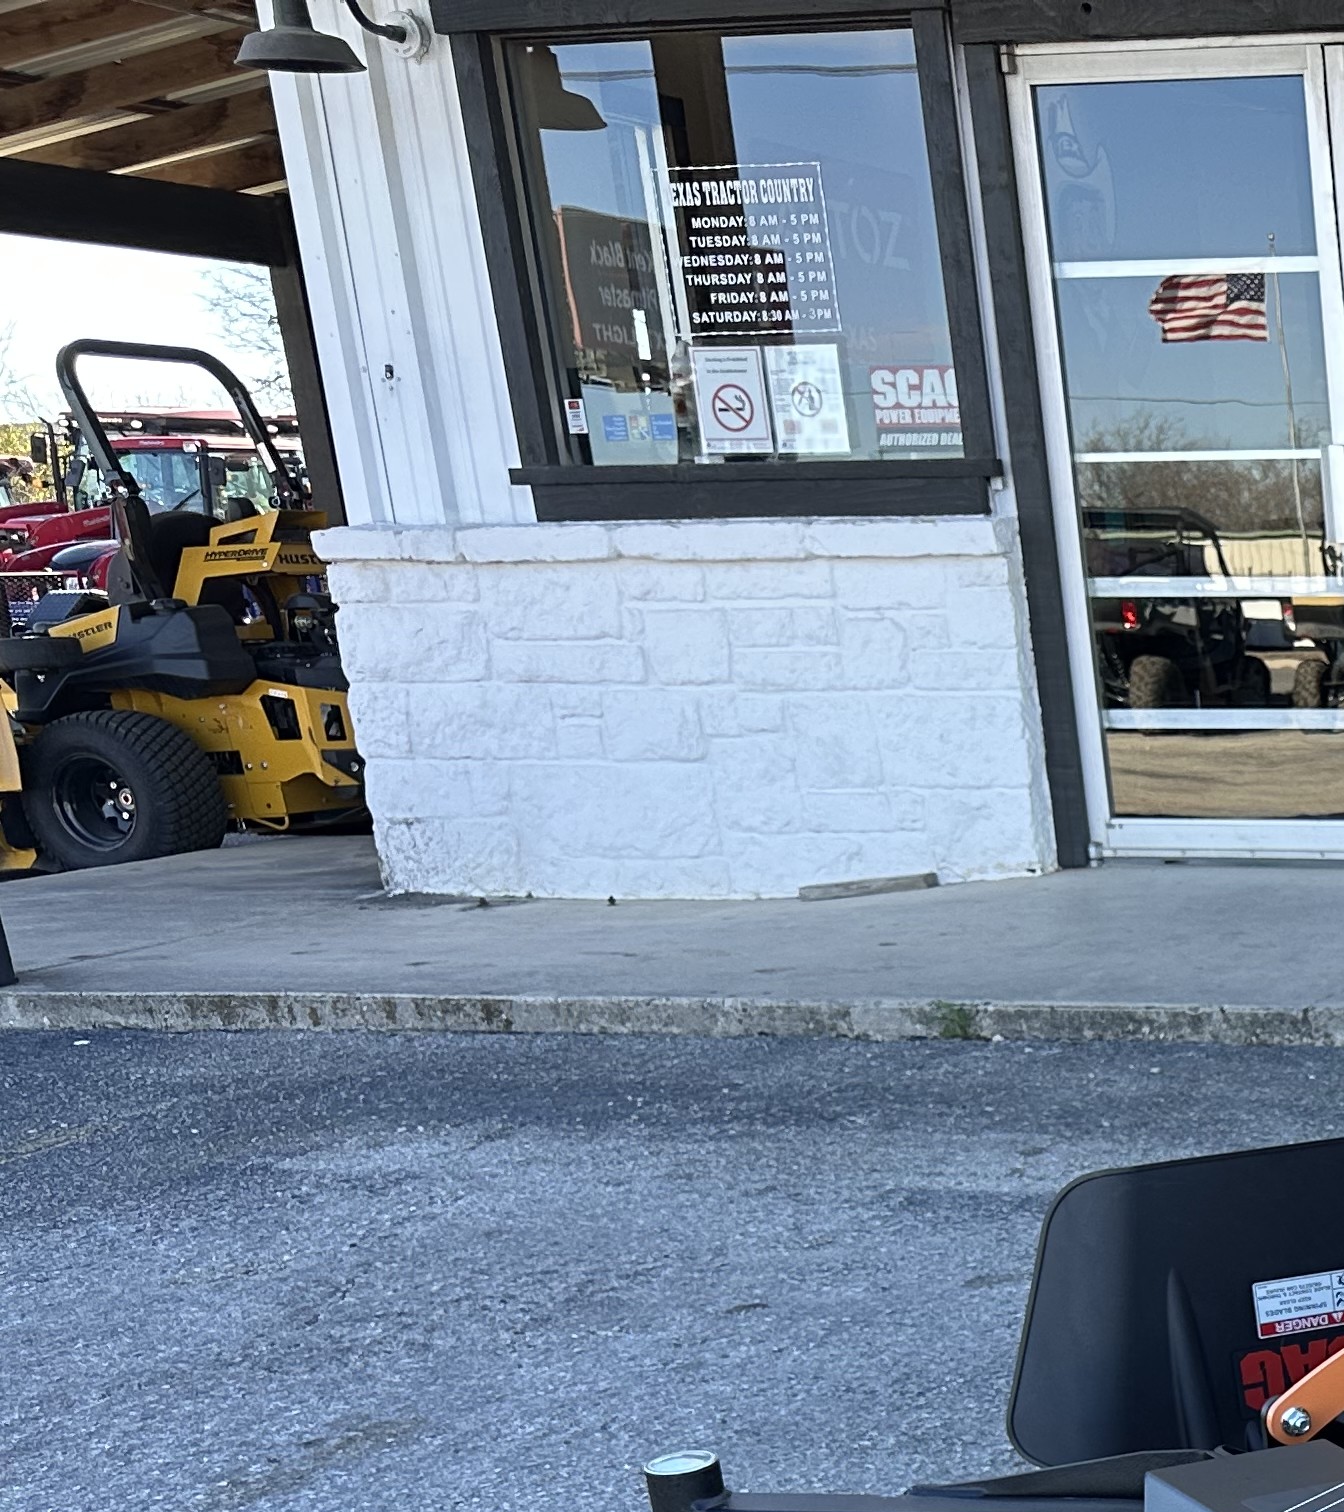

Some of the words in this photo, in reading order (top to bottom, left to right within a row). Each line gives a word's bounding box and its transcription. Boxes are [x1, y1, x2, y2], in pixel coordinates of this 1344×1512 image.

[671, 180, 701, 207] EXAS
[702, 178, 759, 206] TRACTOR
[759, 177, 815, 204] COUNTRY
[749, 215, 756, 227] 8
[759, 215, 778, 227] AM
[790, 214, 797, 226] 5
[801, 213, 819, 225] PM
[751, 234, 758, 246] 8
[761, 233, 781, 246] AM
[793, 233, 800, 245] 5
[803, 232, 822, 244] PM
[754, 254, 761, 265] 8
[765, 253, 783, 265] AM
[795, 252, 802, 264] 5
[806, 251, 825, 263] PM
[757, 272, 764, 284] 8
[767, 271, 786, 283] AM
[798, 271, 805, 282] 5
[808, 270, 827, 282] PM
[759, 292, 766, 303] 8
[769, 290, 789, 302] AM
[800, 290, 807, 301] 5
[811, 289, 830, 301] PM
[762, 310, 783, 321] 8:30
[784, 310, 799, 321] AM
[875, 409, 912, 424] POWER
[880, 433, 939, 446] AUTHORIZED
[279, 554, 322, 565] HUST
[1275, 1314, 1329, 1333] DANGER
